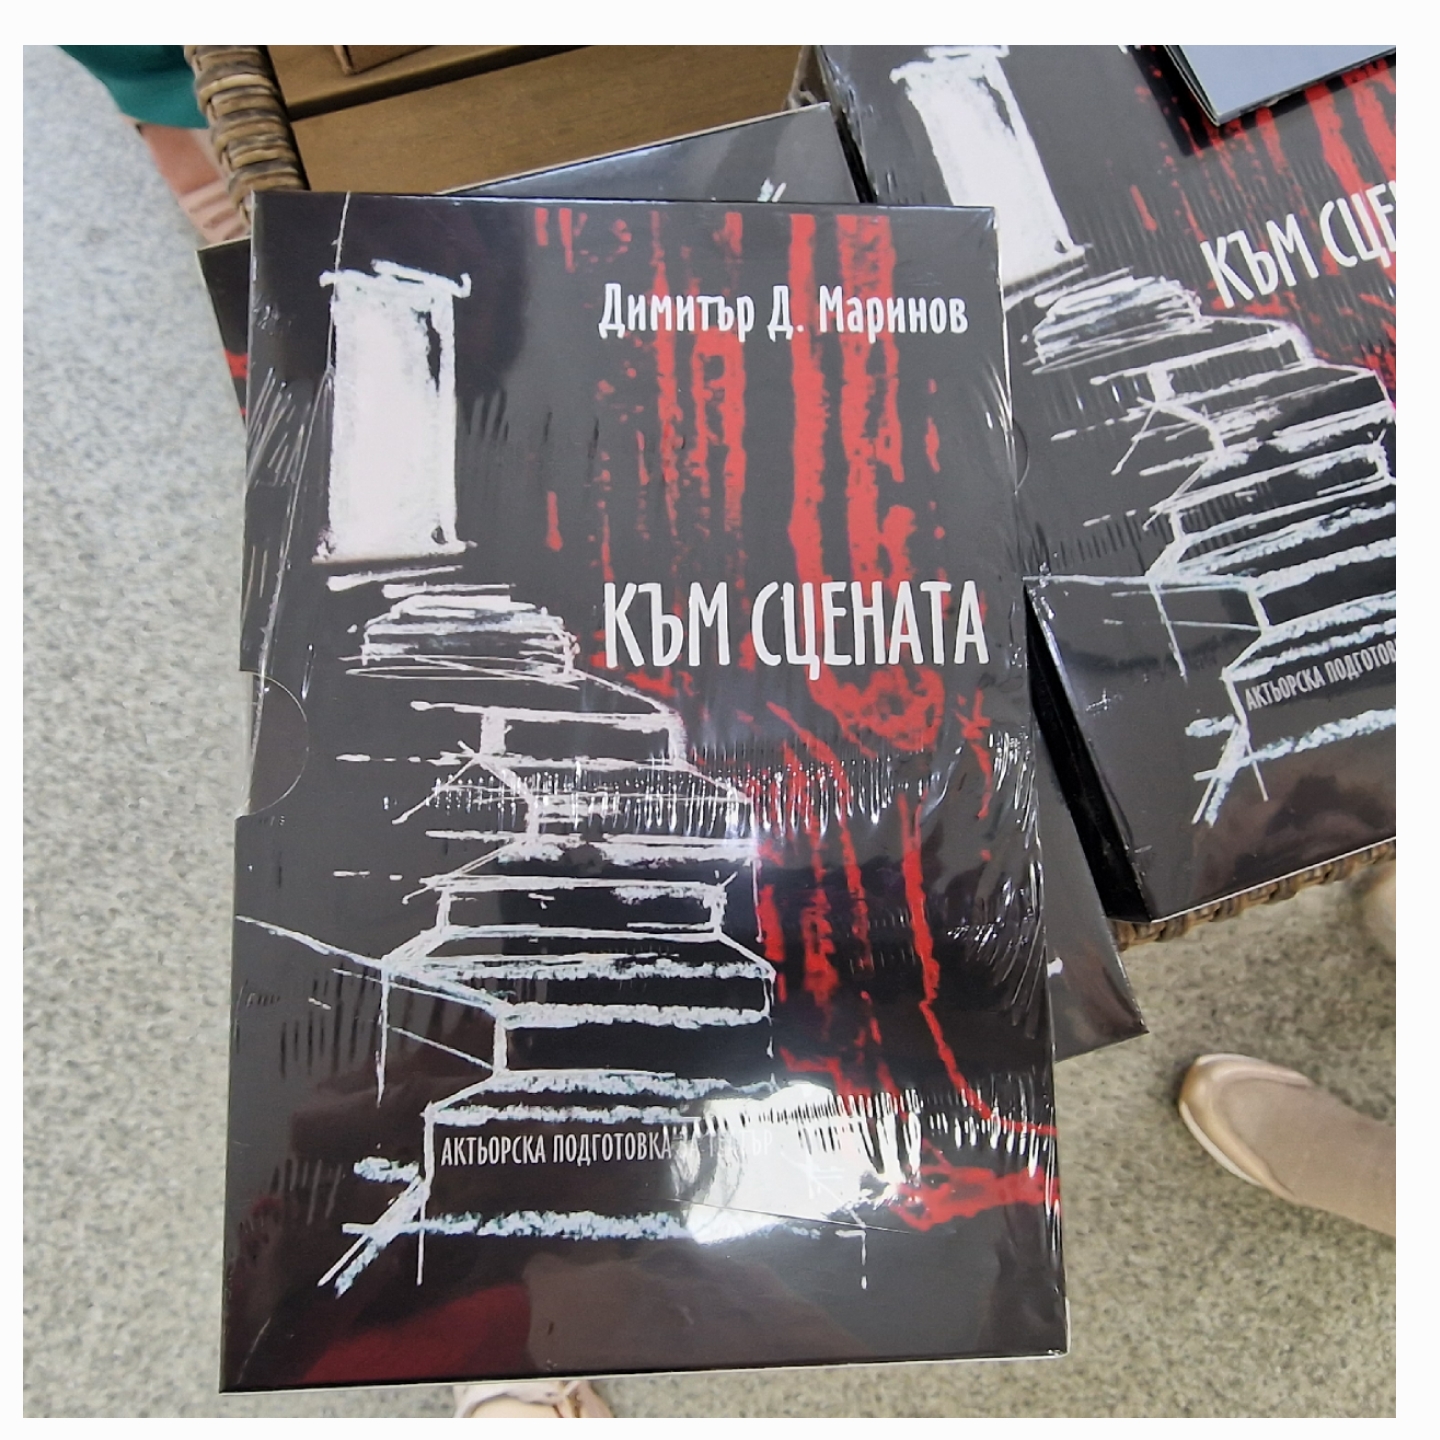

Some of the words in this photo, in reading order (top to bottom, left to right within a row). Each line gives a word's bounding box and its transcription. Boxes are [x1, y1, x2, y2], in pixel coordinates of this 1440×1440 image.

[1200, 213, 1320, 309] КЪМ
[598, 282, 756, 342] Димитър
[767, 284, 805, 342] Д.
[818, 284, 970, 344] Маринов
[603, 581, 731, 669] КЪМ
[751, 580, 990, 681] СЦЕНАТА
[1244, 665, 1325, 711] АКТЬОРСКА
[1324, 638, 1396, 683] ПОДГОТОВ
[440, 1135, 547, 1166] АКТЬОРСКА
[552, 1131, 672, 1165] ПОДГОТОВКА
